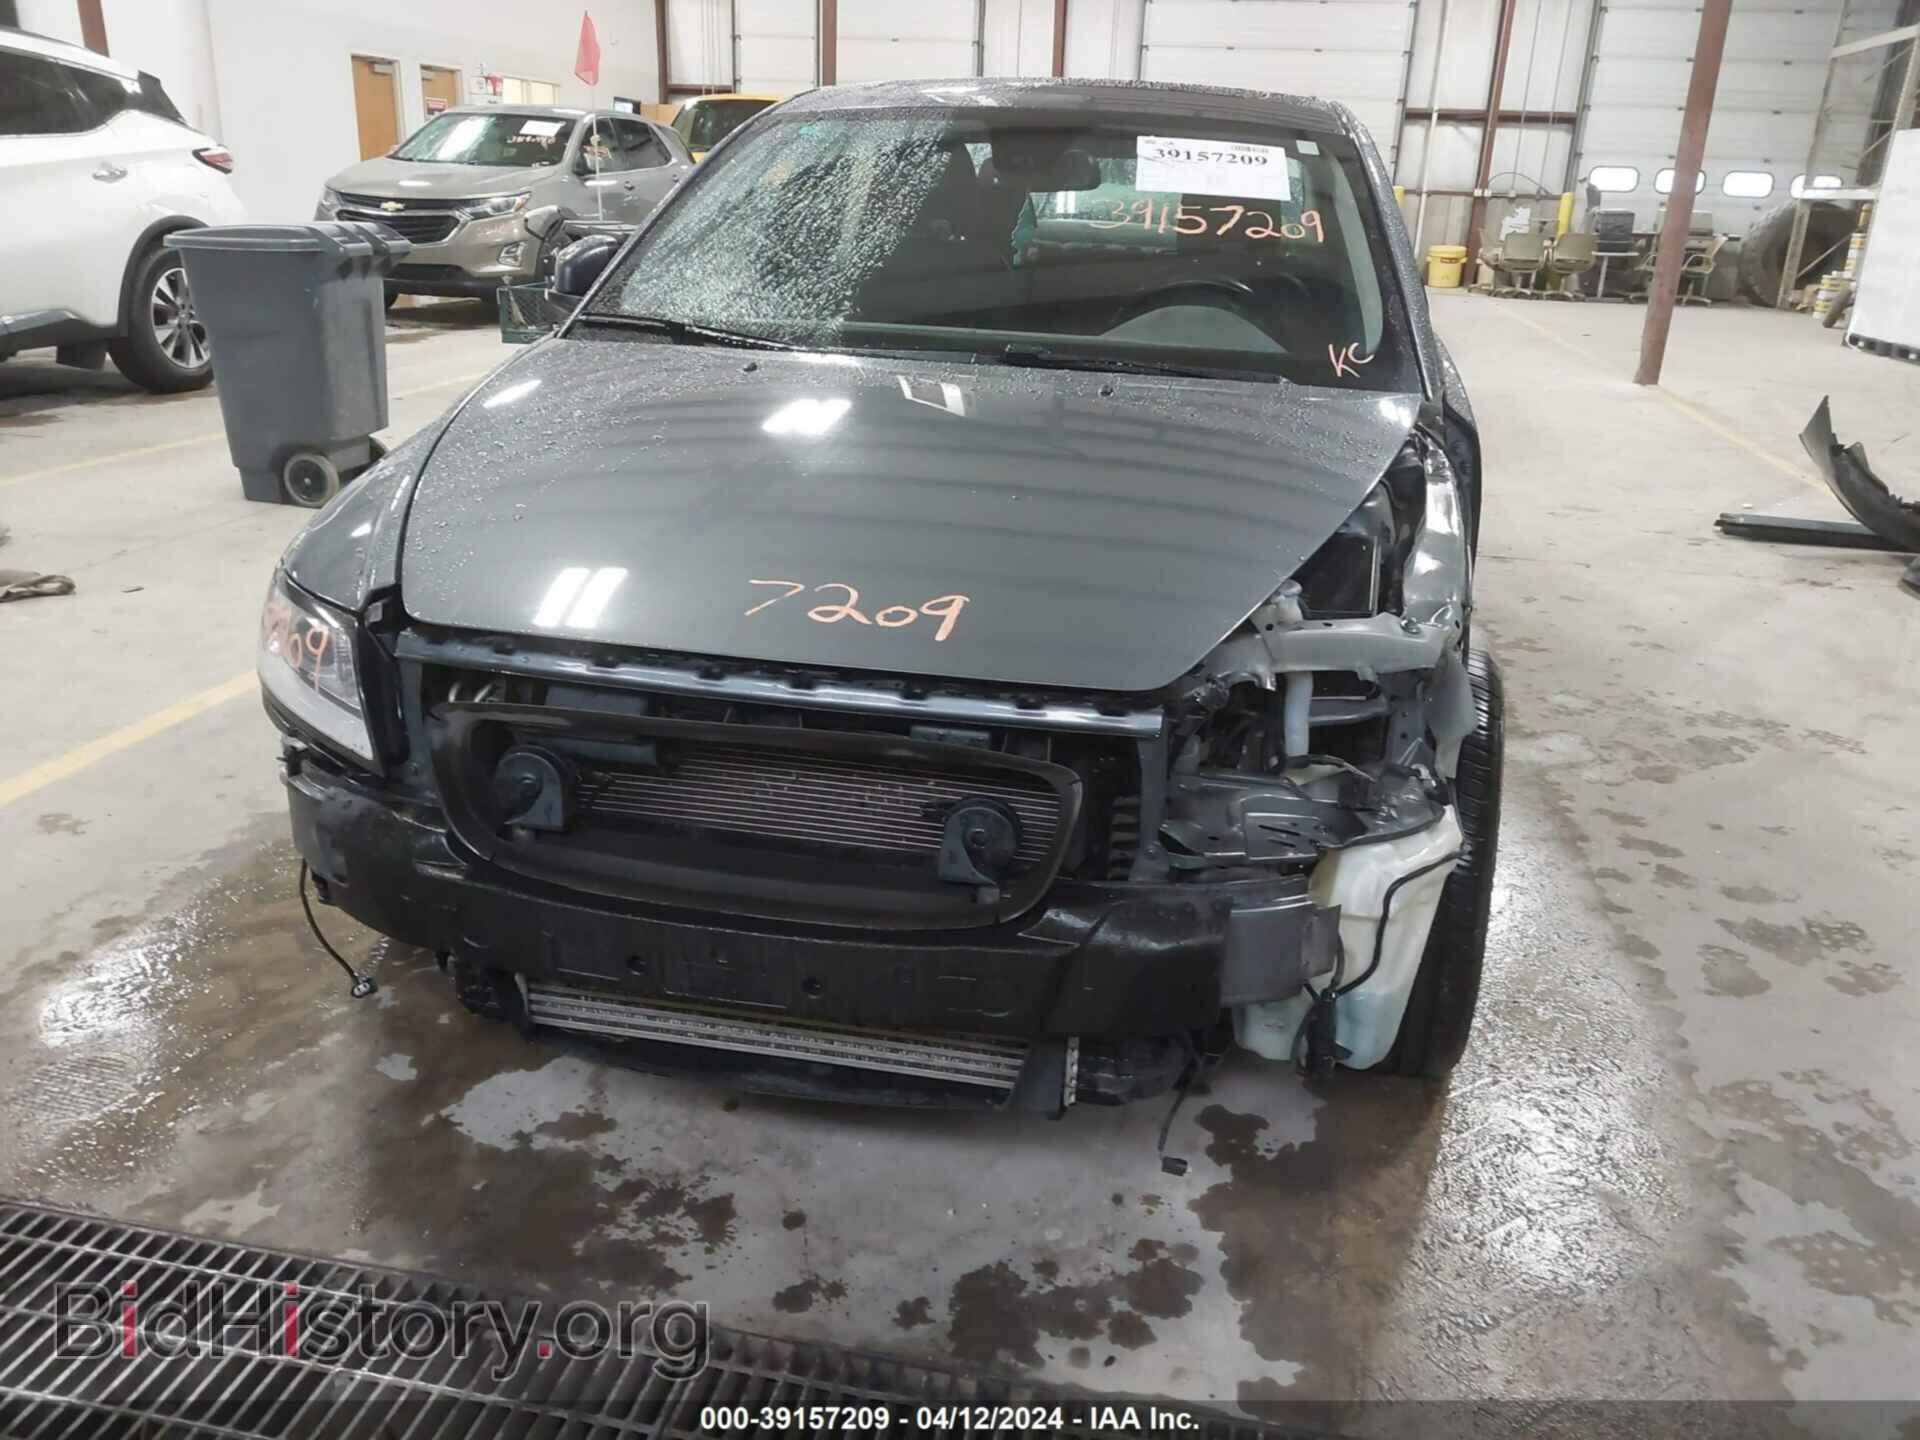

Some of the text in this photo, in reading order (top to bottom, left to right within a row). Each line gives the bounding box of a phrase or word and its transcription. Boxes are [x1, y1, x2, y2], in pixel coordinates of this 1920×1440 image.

[1153, 148, 1268, 166] 39157209
[1089, 199, 1324, 243] 39157209
[1328, 342, 1375, 378] KC
[745, 579, 970, 641] 7209
